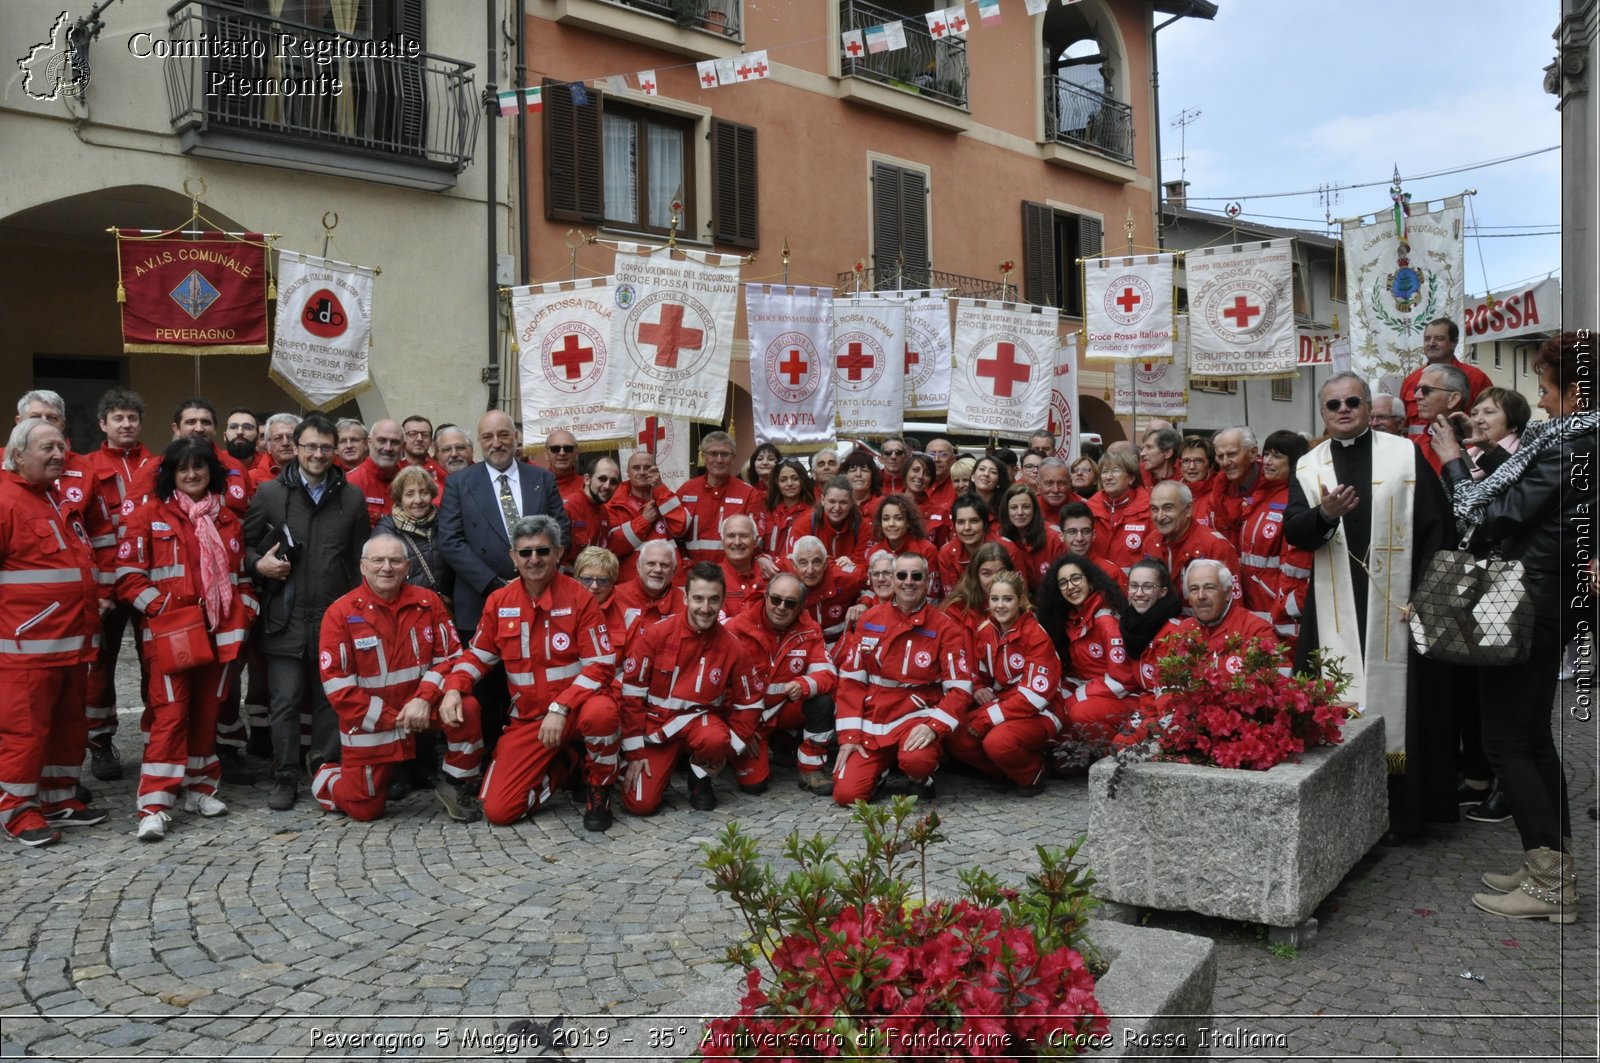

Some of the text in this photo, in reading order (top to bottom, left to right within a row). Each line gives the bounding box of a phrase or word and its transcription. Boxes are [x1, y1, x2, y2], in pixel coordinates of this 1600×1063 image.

[1362, 228, 1448, 251] COMUNE EVERAGNO
[135, 249, 252, 278] A.V.I.S. COMUNALE
[310, 273, 333, 282] ITALIANA
[621, 262, 733, 283] CORPO VOLONTARI DEL SOCCORSO
[616, 273, 737, 293] CROCE ROSSA ITALIANA
[1193, 279, 1216, 308] CROCE
[1215, 268, 1252, 281] ROSSA
[1228, 282, 1262, 292] GINEVRA
[1262, 290, 1271, 299] 22
[629, 292, 677, 322] CONVENZIONE
[681, 294, 690, 303] DI
[690, 300, 714, 331] GINEVRA
[1264, 301, 1274, 329] AGOSTO
[1464, 290, 1540, 336] ROSSA
[522, 298, 612, 343] CROCE ROSSA ITALIA
[840, 314, 864, 323] ROSSA
[867, 316, 893, 339] ITALIANA
[957, 320, 1056, 336] CROCE ROSSA ITALIANA
[962, 312, 981, 320] CORPO
[982, 315, 1011, 323] VOLONTARI
[1026, 320, 1052, 328] SOCCORSO
[1207, 300, 1236, 341] CONVENZIONE
[156, 329, 235, 340] PEVERAGNO
[782, 334, 809, 349] GINEVRA
[914, 318, 946, 351] ITALIANA
[1114, 331, 1137, 340] Rossa
[1140, 330, 1168, 339] Italiana
[277, 338, 366, 360] GRUPPO INTERCOMUNALE
[552, 330, 558, 338] DI
[558, 324, 587, 334] GINEVRA
[587, 328, 596, 337] 22
[594, 336, 604, 366] AGOSTO
[1130, 342, 1164, 352] Peveragno
[275, 351, 303, 363] BOVES
[314, 357, 341, 368] CHIUSA
[344, 363, 366, 372] PESIO
[869, 339, 877, 347] 22
[875, 346, 884, 372] AGOSTO
[1195, 352, 1241, 360] GRUPPO
[1258, 349, 1292, 359] MELLE
[1055, 363, 1069, 377] TALIANA
[1197, 360, 1290, 372] COMITATO LOCALE
[296, 369, 344, 382] PEVERAGNO
[625, 381, 664, 392] COMITATO
[673, 388, 709, 399] LOCALE
[631, 392, 697, 409] MORETTA
[538, 405, 610, 418] COMITATO LOCA
[770, 413, 816, 426] MANTA
[966, 405, 1023, 418] DELEGAZIONE
[572, 421, 616, 432] PIEMONTE
[967, 414, 1030, 429] PEVERAGNO
[662, 470, 684, 479] OCALE
